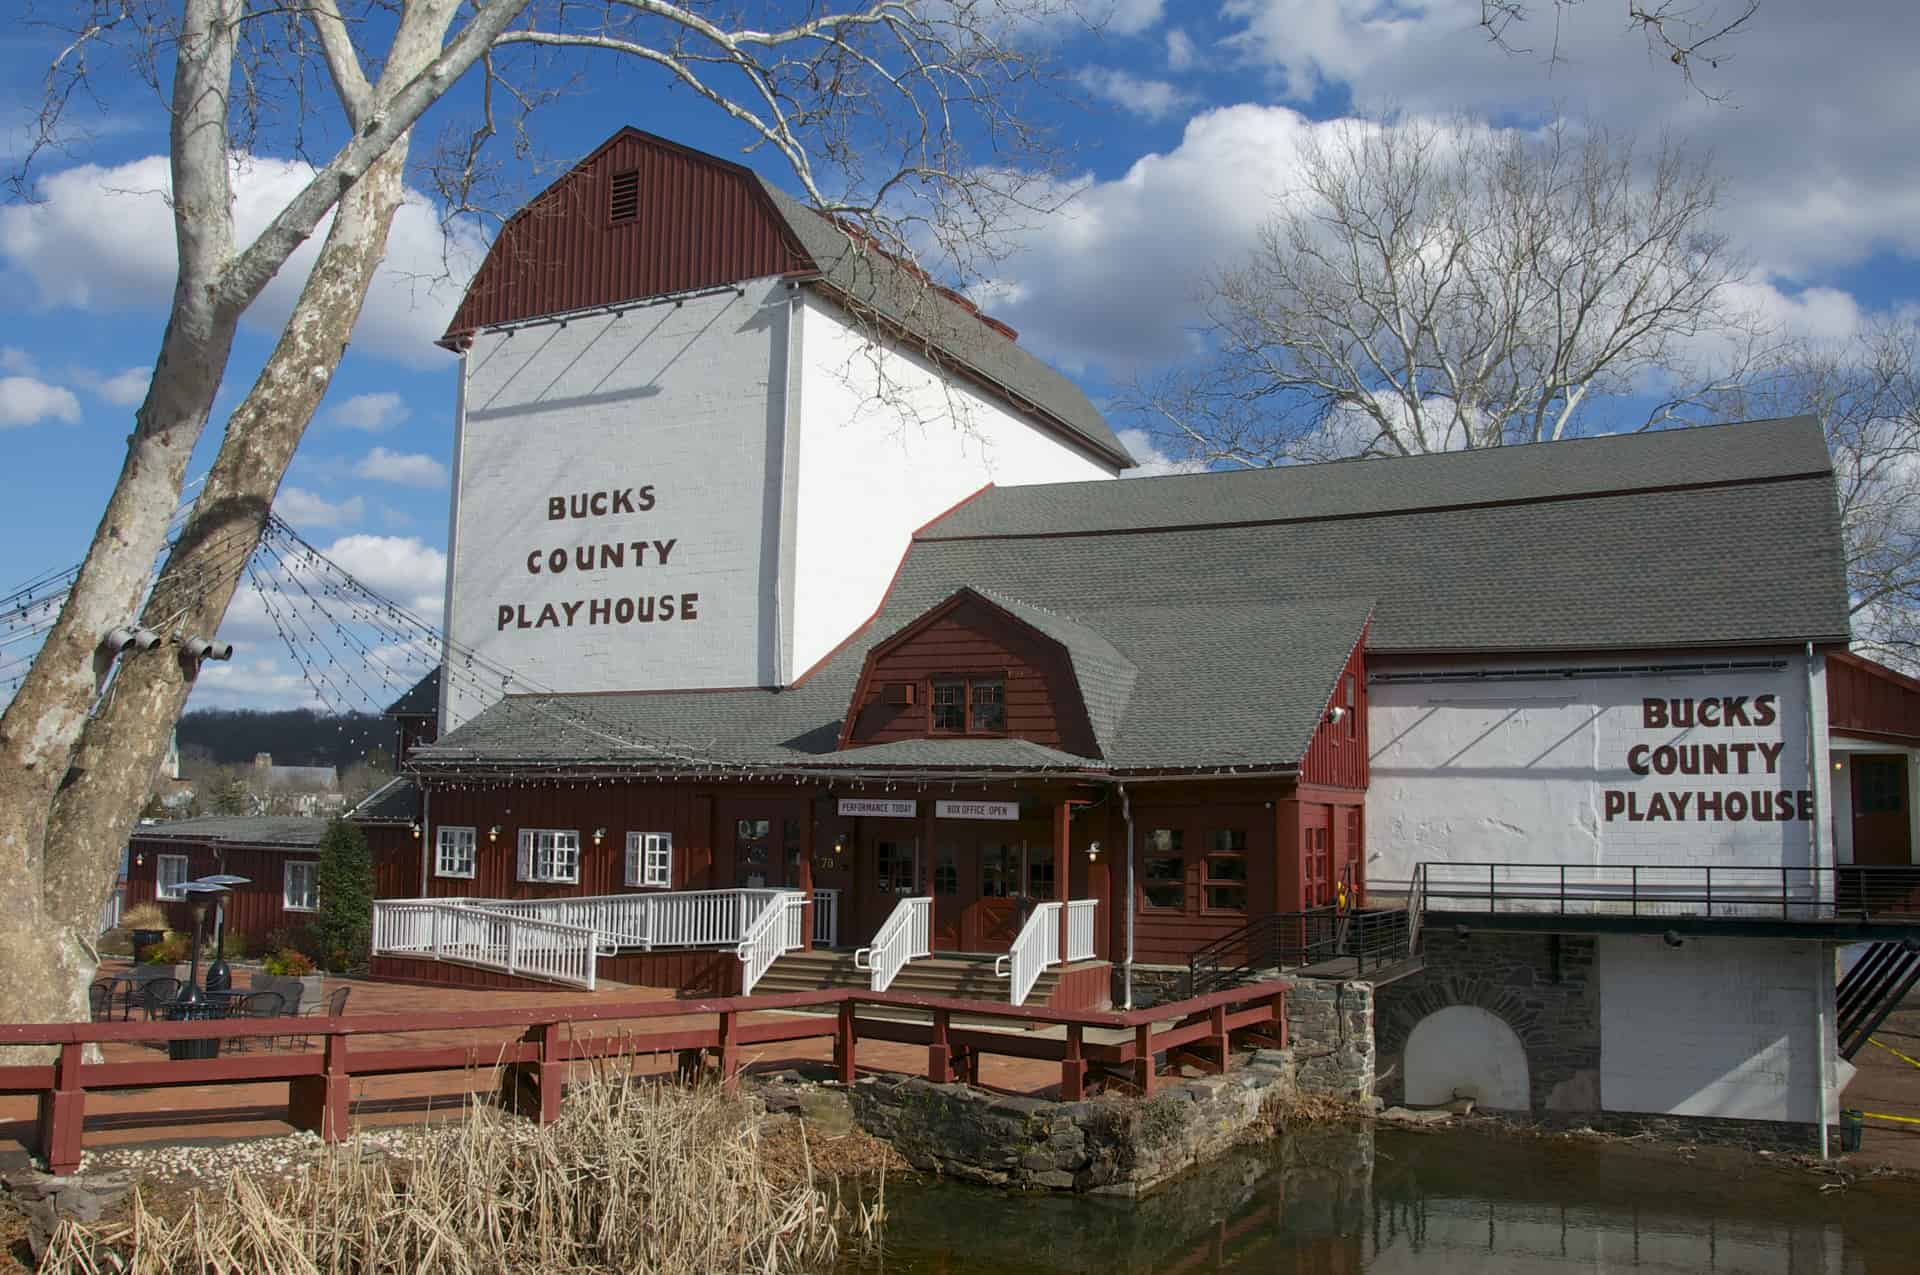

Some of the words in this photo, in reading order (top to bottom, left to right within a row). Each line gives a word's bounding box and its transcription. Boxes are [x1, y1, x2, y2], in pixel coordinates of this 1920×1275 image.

[548, 485, 656, 521] BUCKS
[527, 538, 677, 574] COUNTY
[497, 593, 699, 631] PLAYHOUSE
[1643, 694, 1777, 729] BUCKS
[1627, 742, 1785, 776] COUNTY
[842, 803, 889, 813] PERFORMANCE
[892, 804, 912, 814] TODAY
[947, 805, 960, 814] BOX
[961, 805, 985, 815] OFFICE
[989, 806, 1008, 816] OPEN
[1605, 790, 1814, 822] PLAYHOUSE
